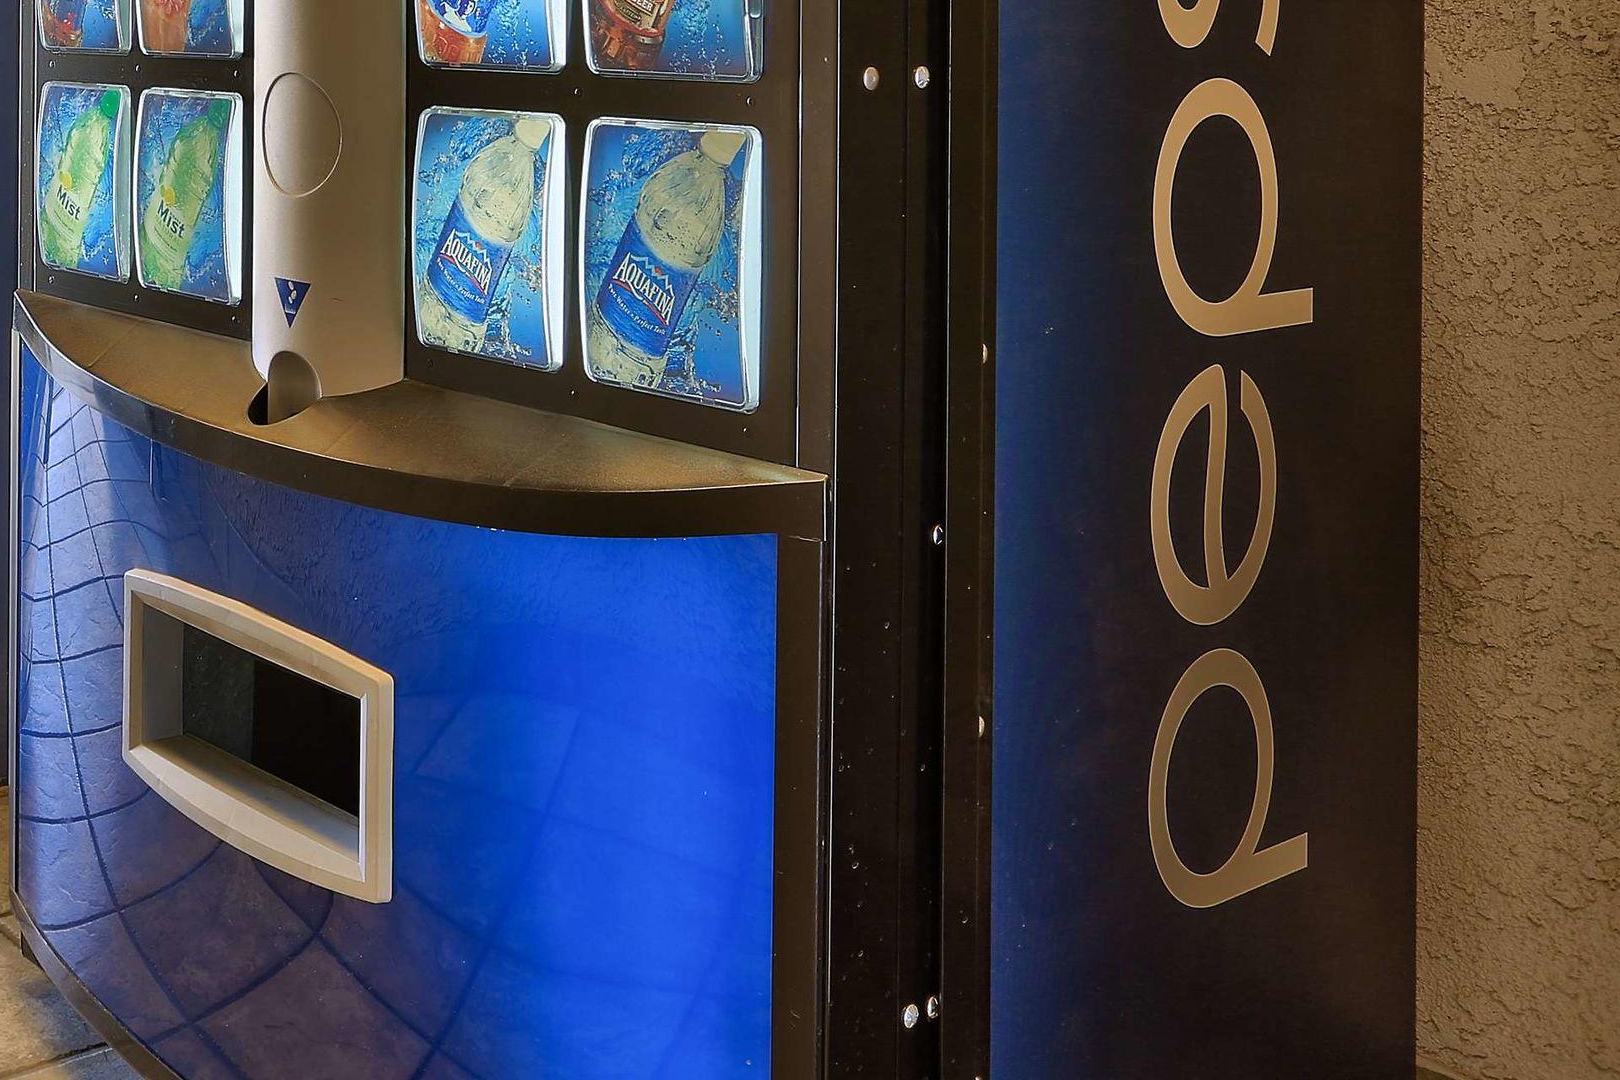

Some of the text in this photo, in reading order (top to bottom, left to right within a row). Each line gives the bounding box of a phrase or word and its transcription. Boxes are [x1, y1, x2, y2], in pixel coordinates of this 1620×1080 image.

[57, 184, 81, 221] Mist
[158, 199, 185, 239] Mist
[440, 228, 492, 296] AQUAFINA
[612, 252, 676, 326] AQUAFINA
